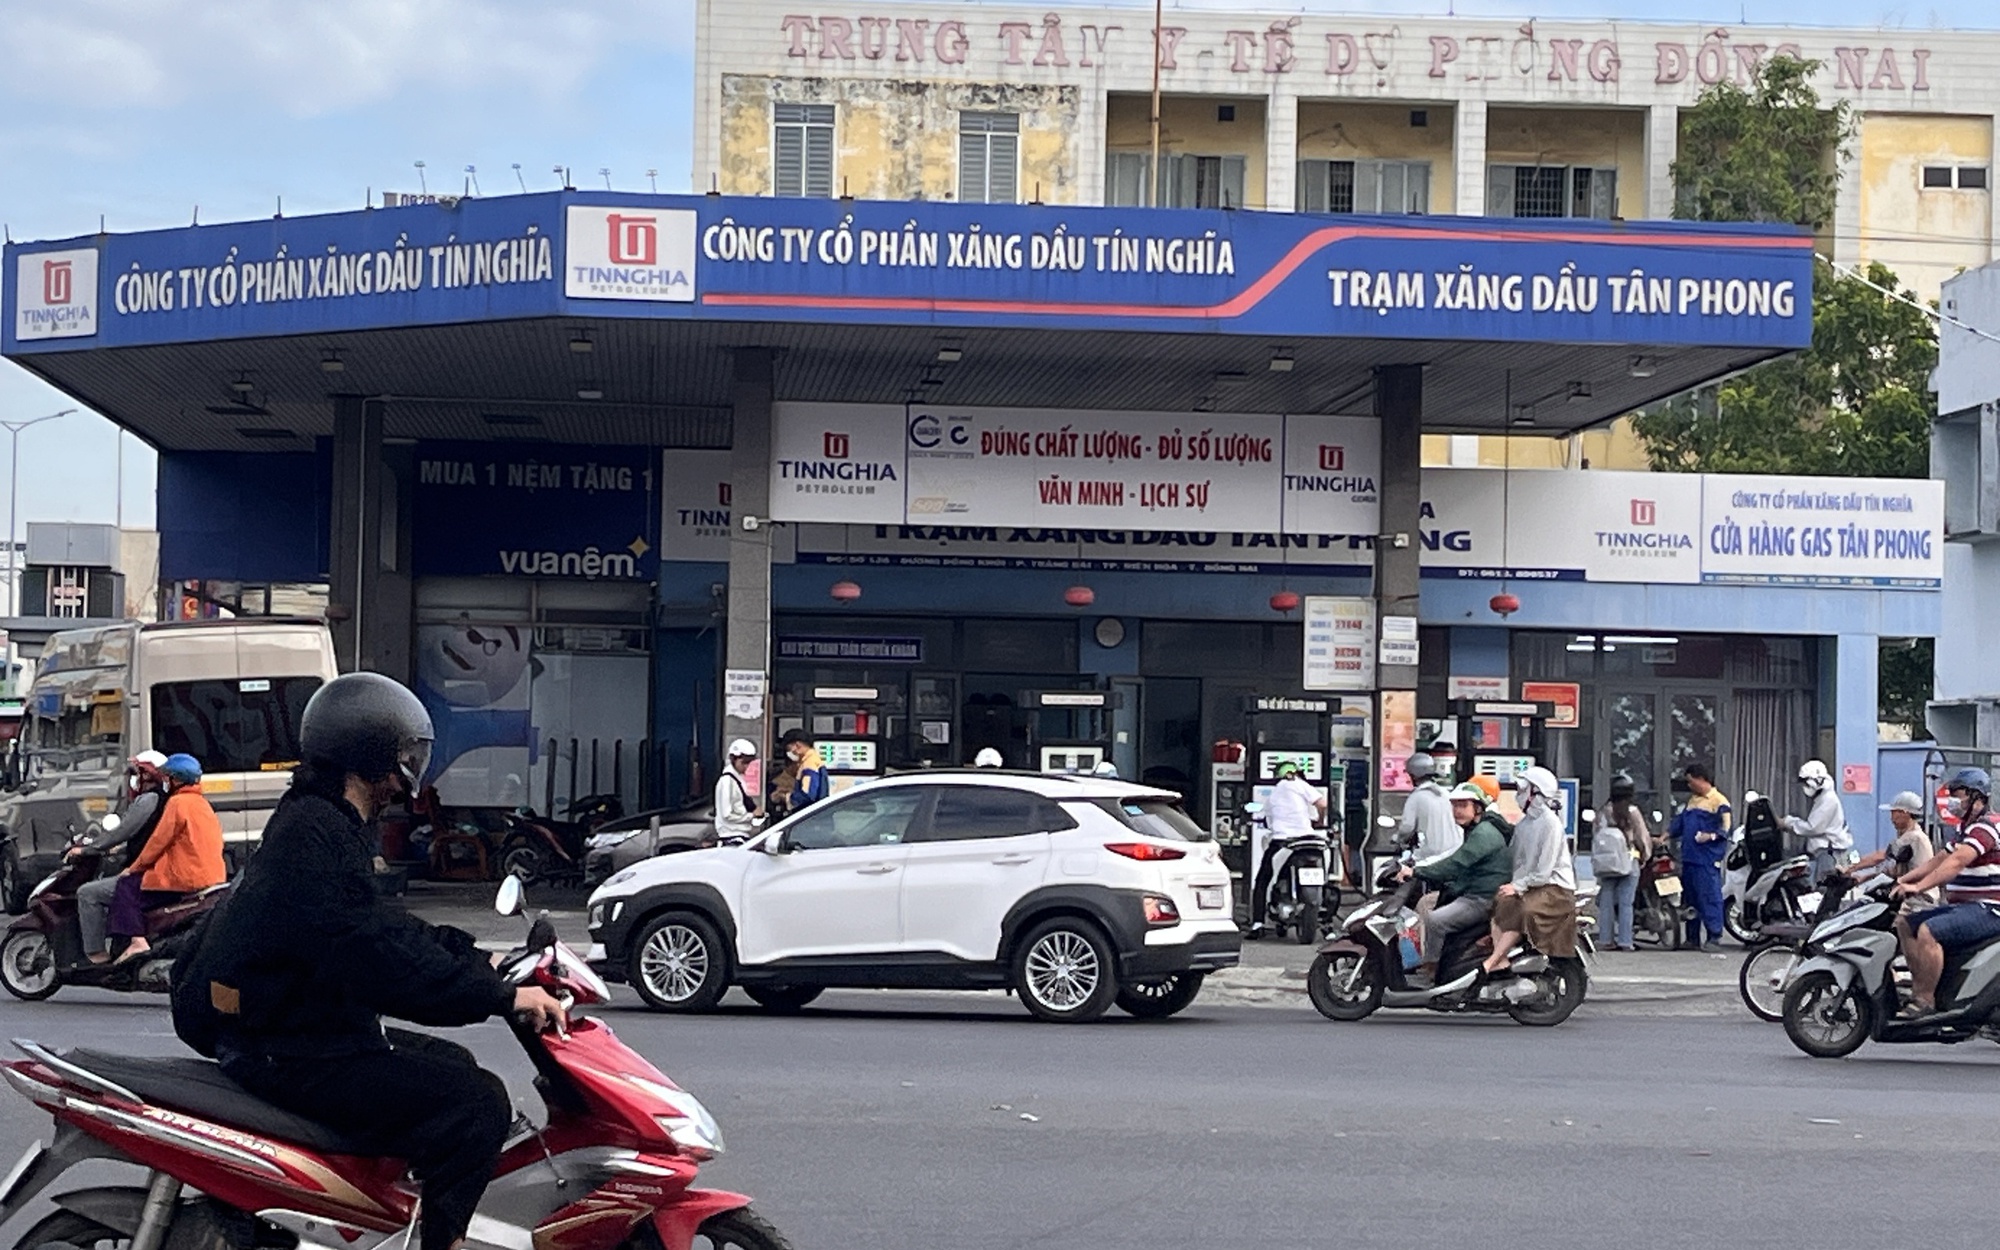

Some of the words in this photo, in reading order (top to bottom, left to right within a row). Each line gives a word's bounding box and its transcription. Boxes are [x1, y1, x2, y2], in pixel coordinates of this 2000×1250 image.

[783, 15, 968, 64] TRUNG
[1834, 47, 1931, 90] NAI
[703, 218, 774, 262] CÔNG
[781, 228, 814, 263] TY
[818, 214, 854, 265] CỔ
[860, 219, 938, 268] PHẦN
[947, 225, 1022, 270] XĂNG
[1030, 224, 1086, 272] DẦU
[1092, 230, 1139, 273] TÍN
[1145, 232, 1236, 275] NGHĨA
[115, 262, 174, 315] CÔNG
[179, 267, 208, 309] TY
[208, 246, 238, 307] CỔ
[241, 244, 304, 304] PHẦN
[307, 244, 372, 299] XĂNG
[375, 232, 423, 293] DẦU
[428, 235, 471, 289] TÍN
[473, 226, 553, 285] NGHĨA
[573, 266, 688, 286] TINNGHIA
[591, 284, 669, 294] PETROLEUM
[1328, 270, 1424, 316] TRẠM
[1434, 264, 1523, 312] XĂNG
[1532, 261, 1598, 313] DẦU
[1607, 270, 1672, 315] TÂN
[1678, 278, 1795, 318] PHONG
[22, 305, 91, 325] TINNGHIA
[981, 426, 1030, 457] ĐÚNG
[1034, 424, 1079, 458] CHẤT
[1084, 430, 1142, 463] LƯỢNG
[1158, 428, 1183, 460] ĐỦ
[1187, 428, 1213, 461] SỐ
[1214, 433, 1272, 466] LƯỢNG
[420, 460, 475, 486] MUA
[485, 463, 496, 487] 1
[507, 459, 561, 493] NỆM
[570, 462, 633, 495] TẶNG
[642, 469, 653, 491] 1
[777, 461, 897, 481] TINNGHIA
[796, 484, 875, 494] PETROLEUM
[1285, 475, 1376, 493] TINNGHIA
[1039, 474, 1072, 505] VĂN
[1077, 482, 1124, 506] MINH
[1140, 482, 1179, 512] LỊCH
[1186, 480, 1211, 513] SỰ
[1595, 532, 1693, 549] TINNGHIA
[1711, 516, 1742, 555] CỬA
[1748, 520, 1795, 556] HÀNG
[1801, 527, 1832, 557] GAS
[1838, 522, 1869, 559] TÂN
[1874, 529, 1931, 560] PHONG
